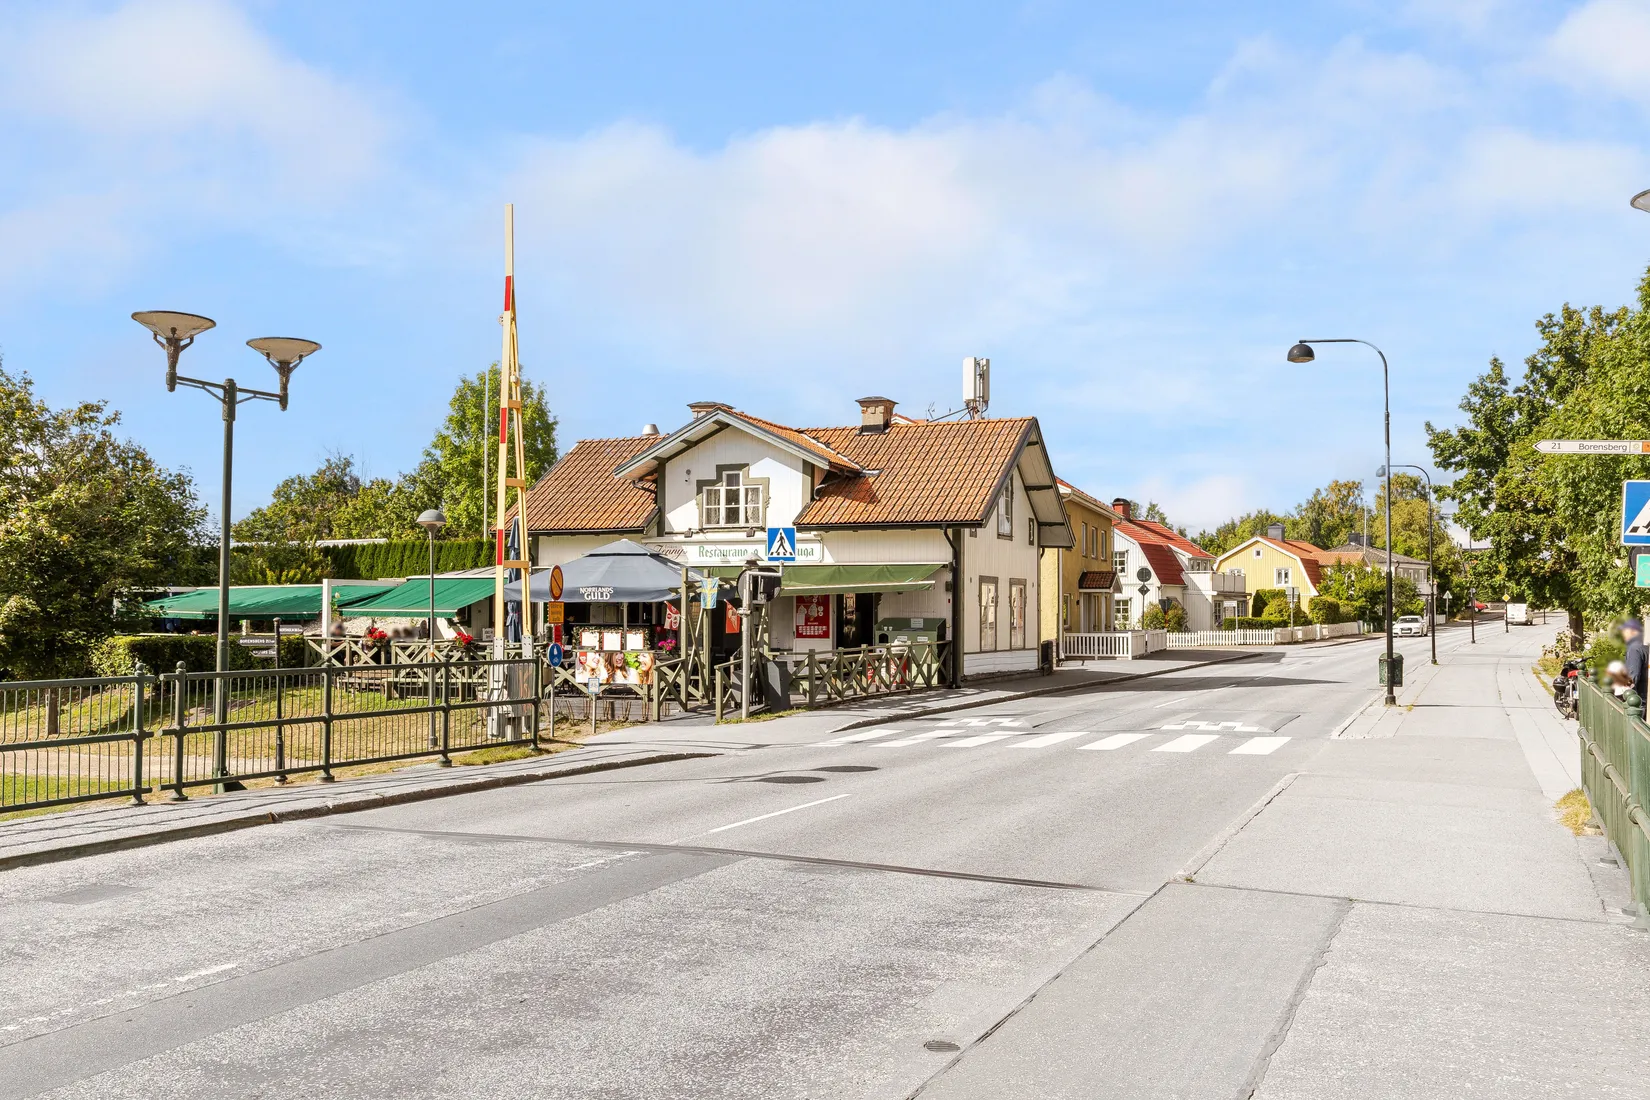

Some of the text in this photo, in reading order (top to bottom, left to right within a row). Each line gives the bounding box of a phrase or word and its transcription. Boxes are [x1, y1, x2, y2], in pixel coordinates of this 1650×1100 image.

[1551, 442, 1628, 452] 21 Borensberg
[584, 592, 611, 601] GULD
